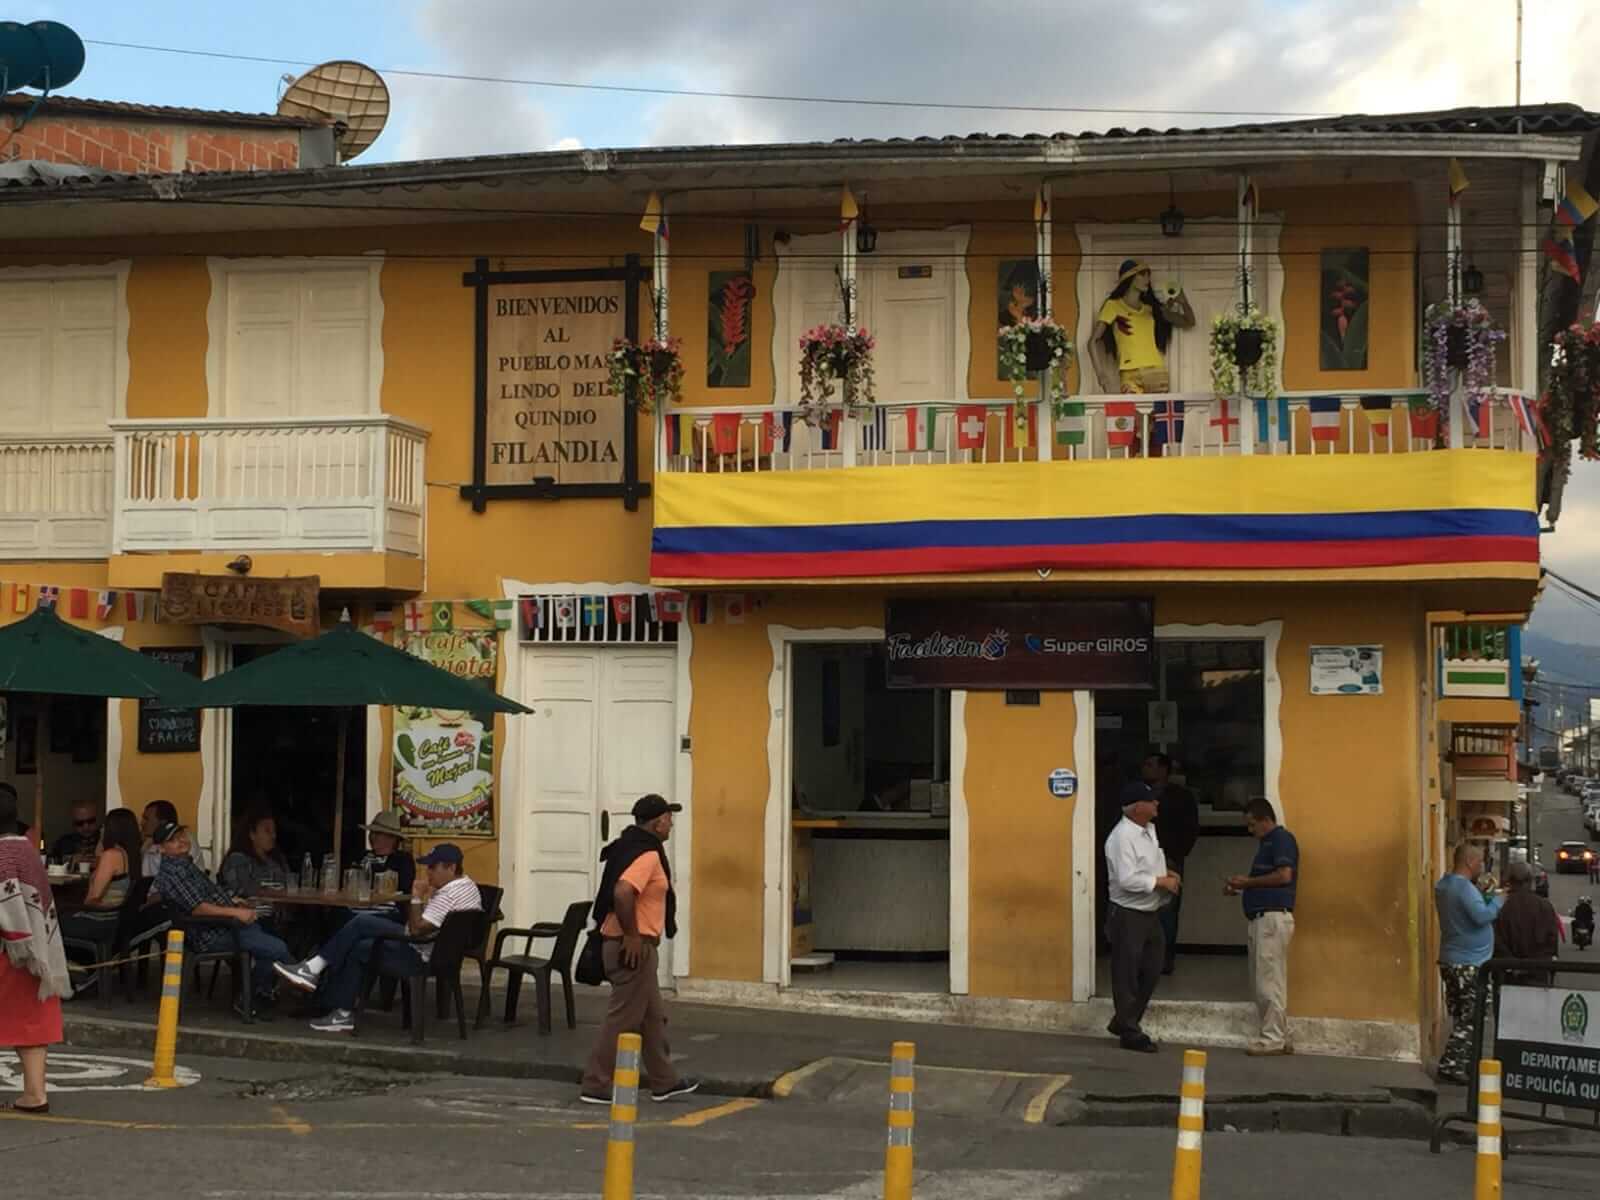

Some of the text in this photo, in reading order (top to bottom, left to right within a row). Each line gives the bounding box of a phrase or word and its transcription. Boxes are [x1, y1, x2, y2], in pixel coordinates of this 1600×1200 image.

[496, 296, 619, 317] BIENVENIDOS
[543, 328, 571, 343] AL
[499, 355, 571, 373] PUEBLO
[501, 381, 609, 399] LINDO DEL
[515, 409, 597, 429] QUINDIO
[491, 440, 619, 465] FILANDIA
[1043, 637, 1148, 655] SuperGIROS
[1521, 1051, 1600, 1074] DEPARTAME
[1506, 1073, 1523, 1088] DE
[1526, 1074, 1577, 1096] POLICÍA
